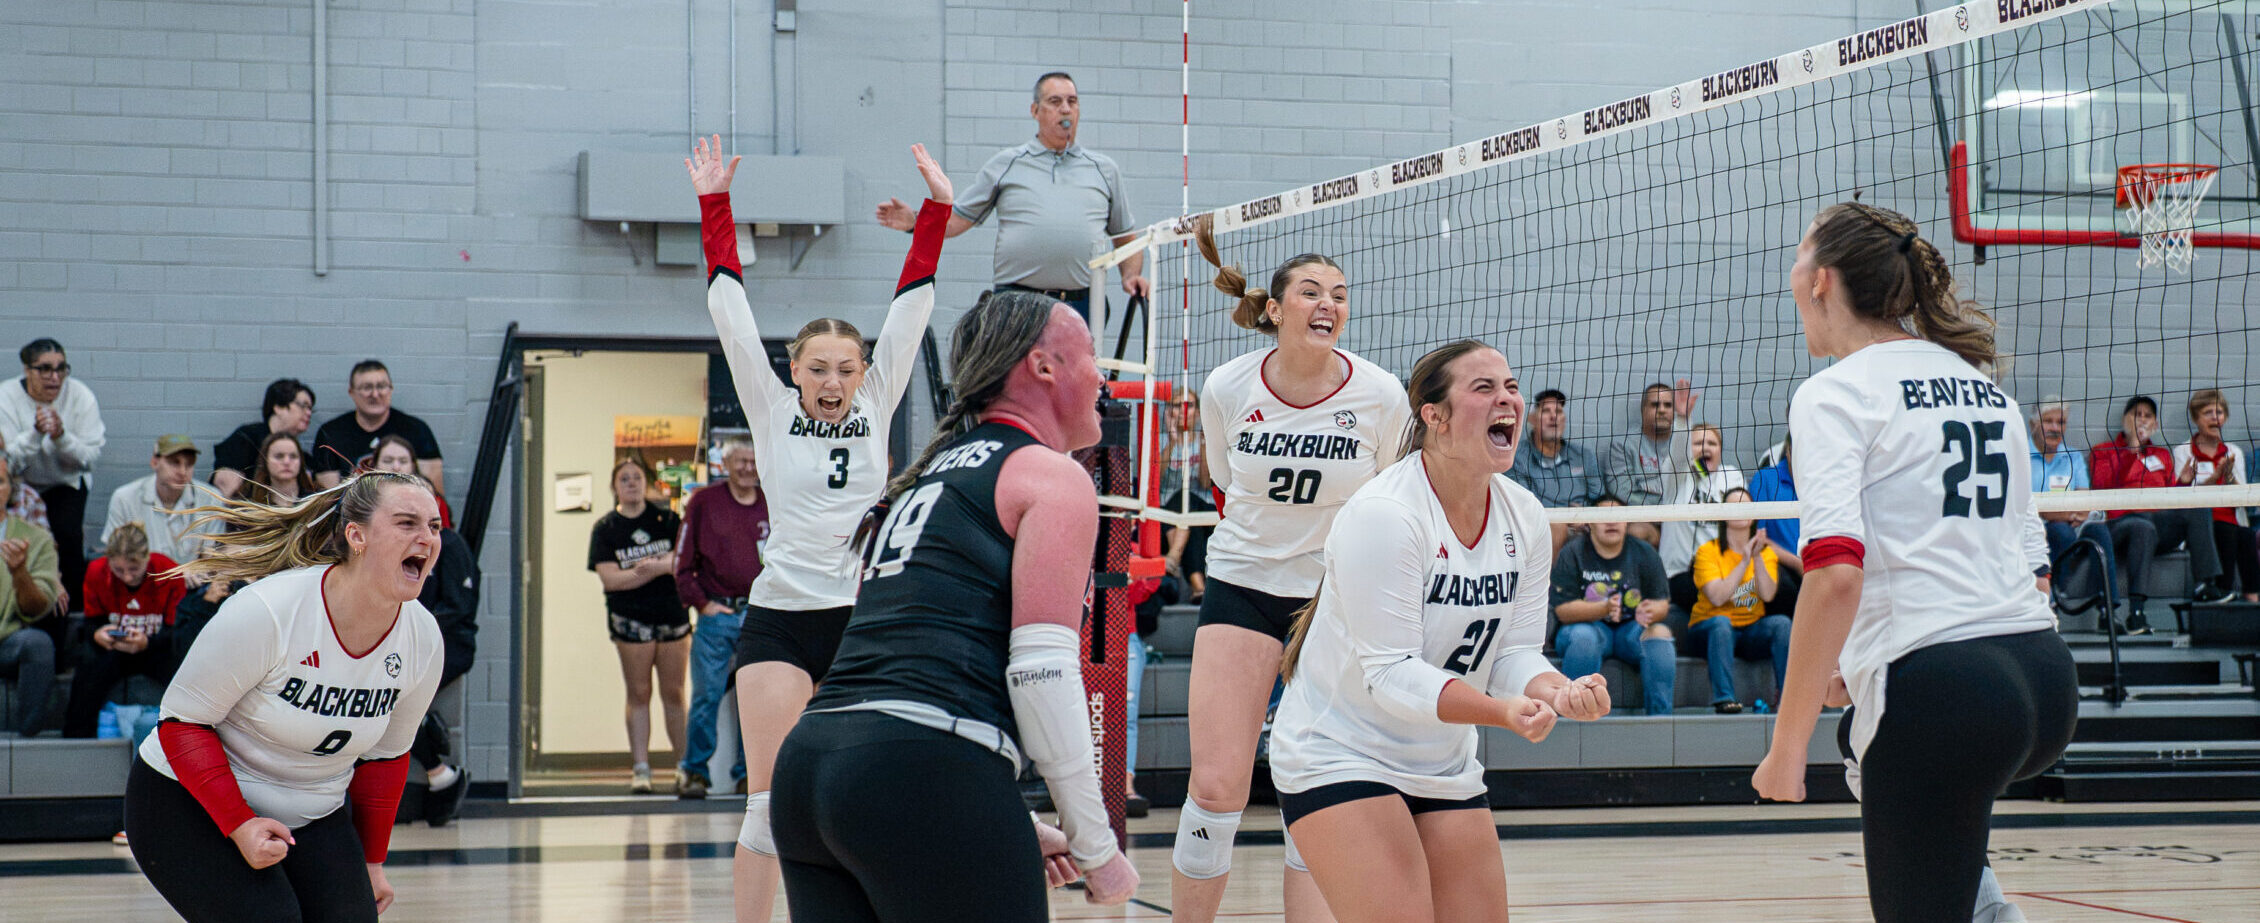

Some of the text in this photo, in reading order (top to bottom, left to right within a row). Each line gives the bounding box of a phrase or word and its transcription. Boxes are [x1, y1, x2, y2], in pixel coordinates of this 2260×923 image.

[1241, 194, 1282, 223] BLACKBURN
[1312, 174, 1359, 205] BLACKBURN
[1392, 152, 1444, 185] BLACKBURN
[1482, 125, 1541, 162] BLACKBURN
[1584, 94, 1651, 135] BLACKBURN
[1702, 58, 1779, 103] BLACKBURN
[1838, 16, 1928, 67] BLACKBURN
[1899, 377, 2007, 411] BEAVERS
[827, 448, 850, 489] 3
[1237, 432, 1360, 460] BLACKBURN
[1941, 420, 2009, 519] 25
[1268, 468, 1322, 504] 20
[862, 481, 943, 581] 19
[1443, 618, 1501, 676] 21
